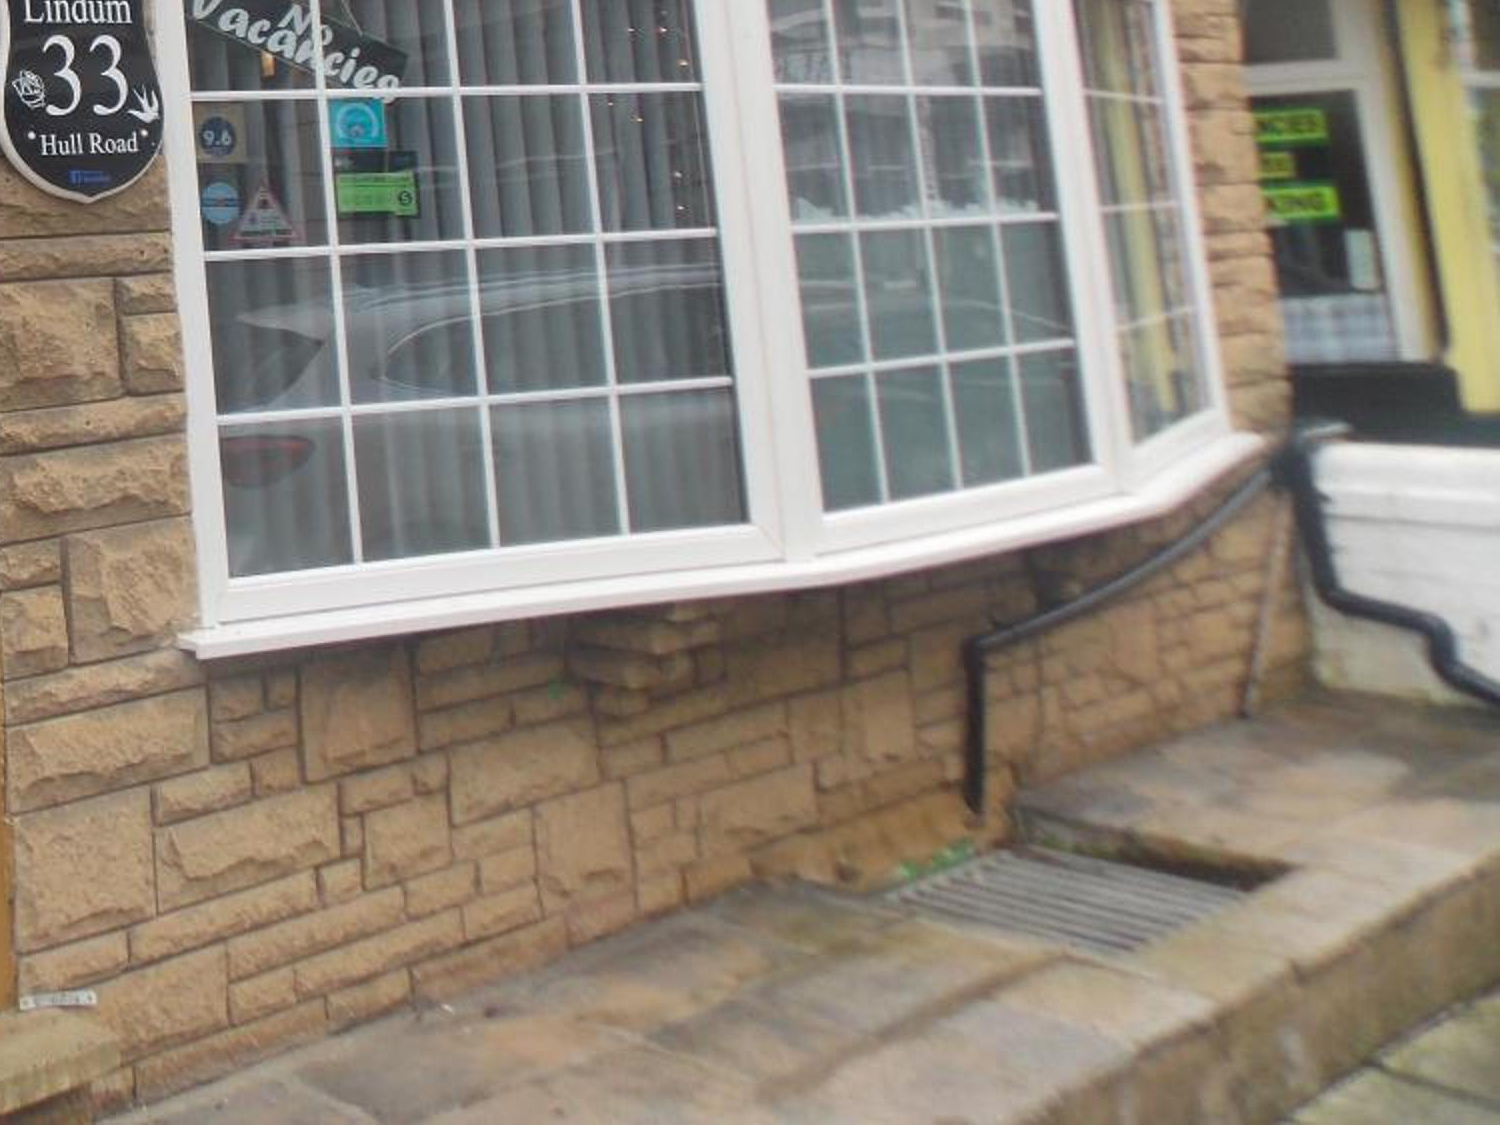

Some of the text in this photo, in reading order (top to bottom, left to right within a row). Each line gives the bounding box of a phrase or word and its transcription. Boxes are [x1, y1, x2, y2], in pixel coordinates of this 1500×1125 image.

[42, 34, 129, 116] 33
[40, 131, 139, 156] Hull Road
[203, 130, 233, 147] 9.6
